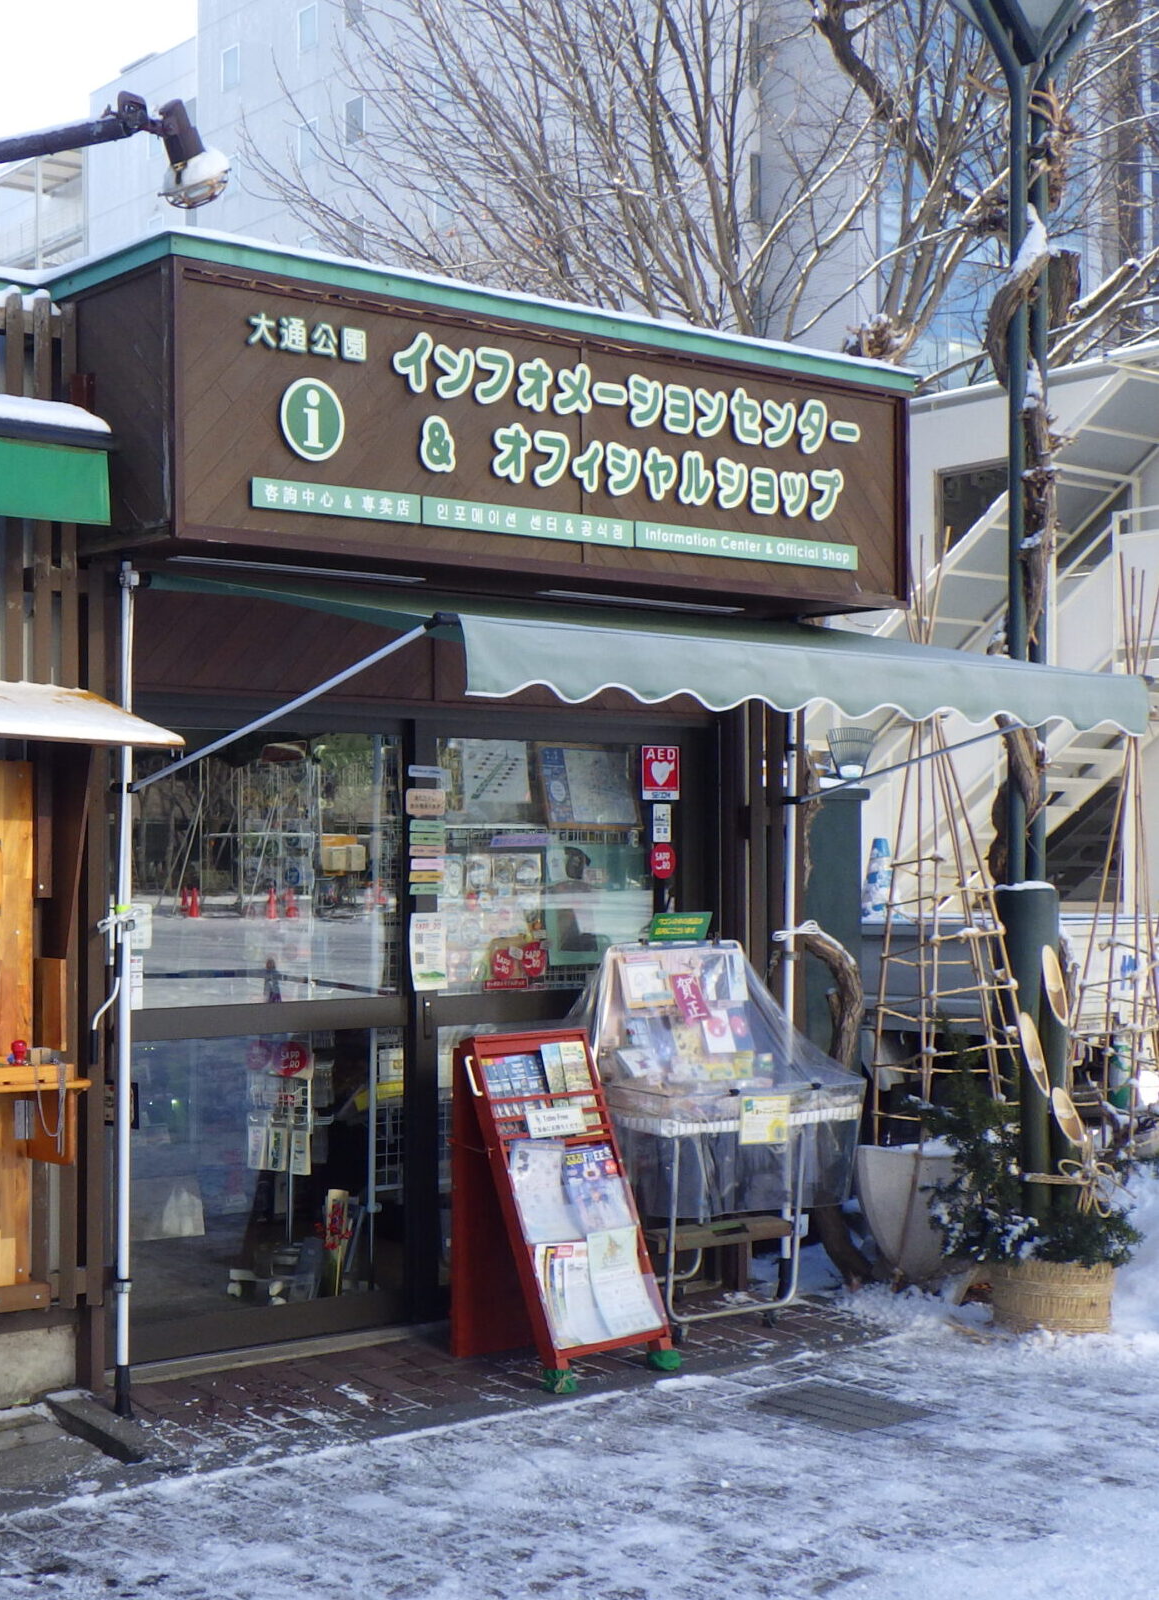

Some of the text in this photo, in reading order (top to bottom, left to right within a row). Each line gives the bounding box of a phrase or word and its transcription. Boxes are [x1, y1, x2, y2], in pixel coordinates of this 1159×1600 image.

[248, 313, 367, 362] 大通公園
[393, 332, 861, 454] インフォメーションセンター
[420, 415, 844, 521] & オフィシャルショップ
[344, 494, 353, 510] &
[645, 527, 850, 565] Information Center & Official Shop
[646, 748, 676, 761] AED
[676, 975, 707, 1019] 賀正
